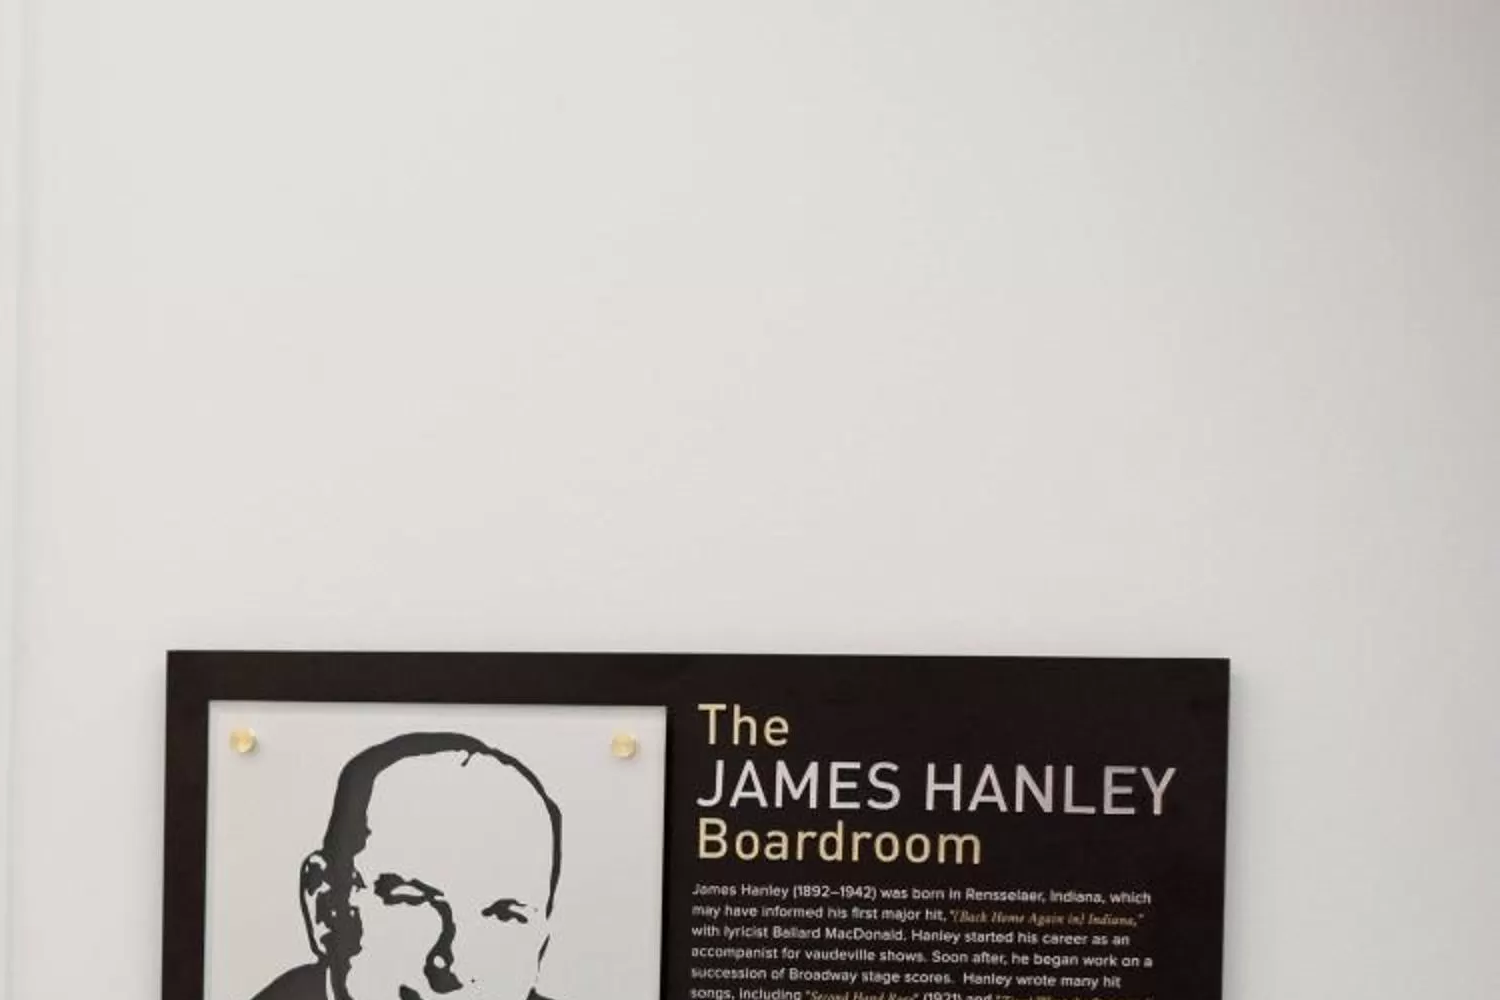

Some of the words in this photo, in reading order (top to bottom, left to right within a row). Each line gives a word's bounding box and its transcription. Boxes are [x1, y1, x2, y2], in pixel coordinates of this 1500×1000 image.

[697, 703, 789, 746] The
[696, 759, 901, 810] JAMES
[925, 762, 1177, 815] HANLEY
[698, 817, 981, 864] Boardroom
[691, 883, 737, 896] James
[740, 883, 789, 899] Hanley
[879, 888, 909, 899] was
[911, 887, 945, 900] born
[948, 887, 962, 900] in
[965, 887, 1047, 903] Rensselaer,
[1049, 889, 1106, 904] Indiana,
[1109, 891, 1152, 904] which
[691, 905, 722, 919] may
[723, 904, 759, 917] have
[761, 904, 824, 918] informed
[827, 906, 849, 919] his
[851, 905, 879, 919] first
[880, 907, 922, 922] major
[924, 907, 947, 922] hit,
[990, 910, 1025, 923] Home
[1027, 911, 1065, 927] Again
[691, 923, 721, 936] with
[723, 924, 769, 940] lyricist
[770, 925, 821, 939] Ballard
[824, 926, 907, 941] MacDonald.
[911, 928, 961, 944] Hanley
[963, 931, 1015, 943] started
[1016, 931, 1039, 944] his
[1041, 933, 1089, 945] career
[1091, 935, 1109, 945] as
[1111, 935, 1131, 945] an
[691, 946, 779, 960] accompanist
[781, 946, 802, 959] for
[804, 947, 877, 961] vaudeville
[878, 949, 928, 962] shows.
[931, 949, 969, 963] Soon
[970, 951, 1008, 965] after,
[1011, 951, 1030, 964] he
[1033, 952, 1079, 968] began
[1081, 953, 1119, 966] work
[1120, 956, 1141, 967] on
[1143, 957, 1153, 967] a
[691, 967, 768, 979] succession
[770, 967, 786, 980] of
[788, 967, 859, 984] Broadway
[861, 970, 902, 984] stage
[903, 972, 954, 984] scores.
[963, 971, 1013, 987] Hanley
[1015, 974, 1057, 986] wrote
[1060, 976, 1100, 990] many
[1102, 975, 1122, 988] hit
